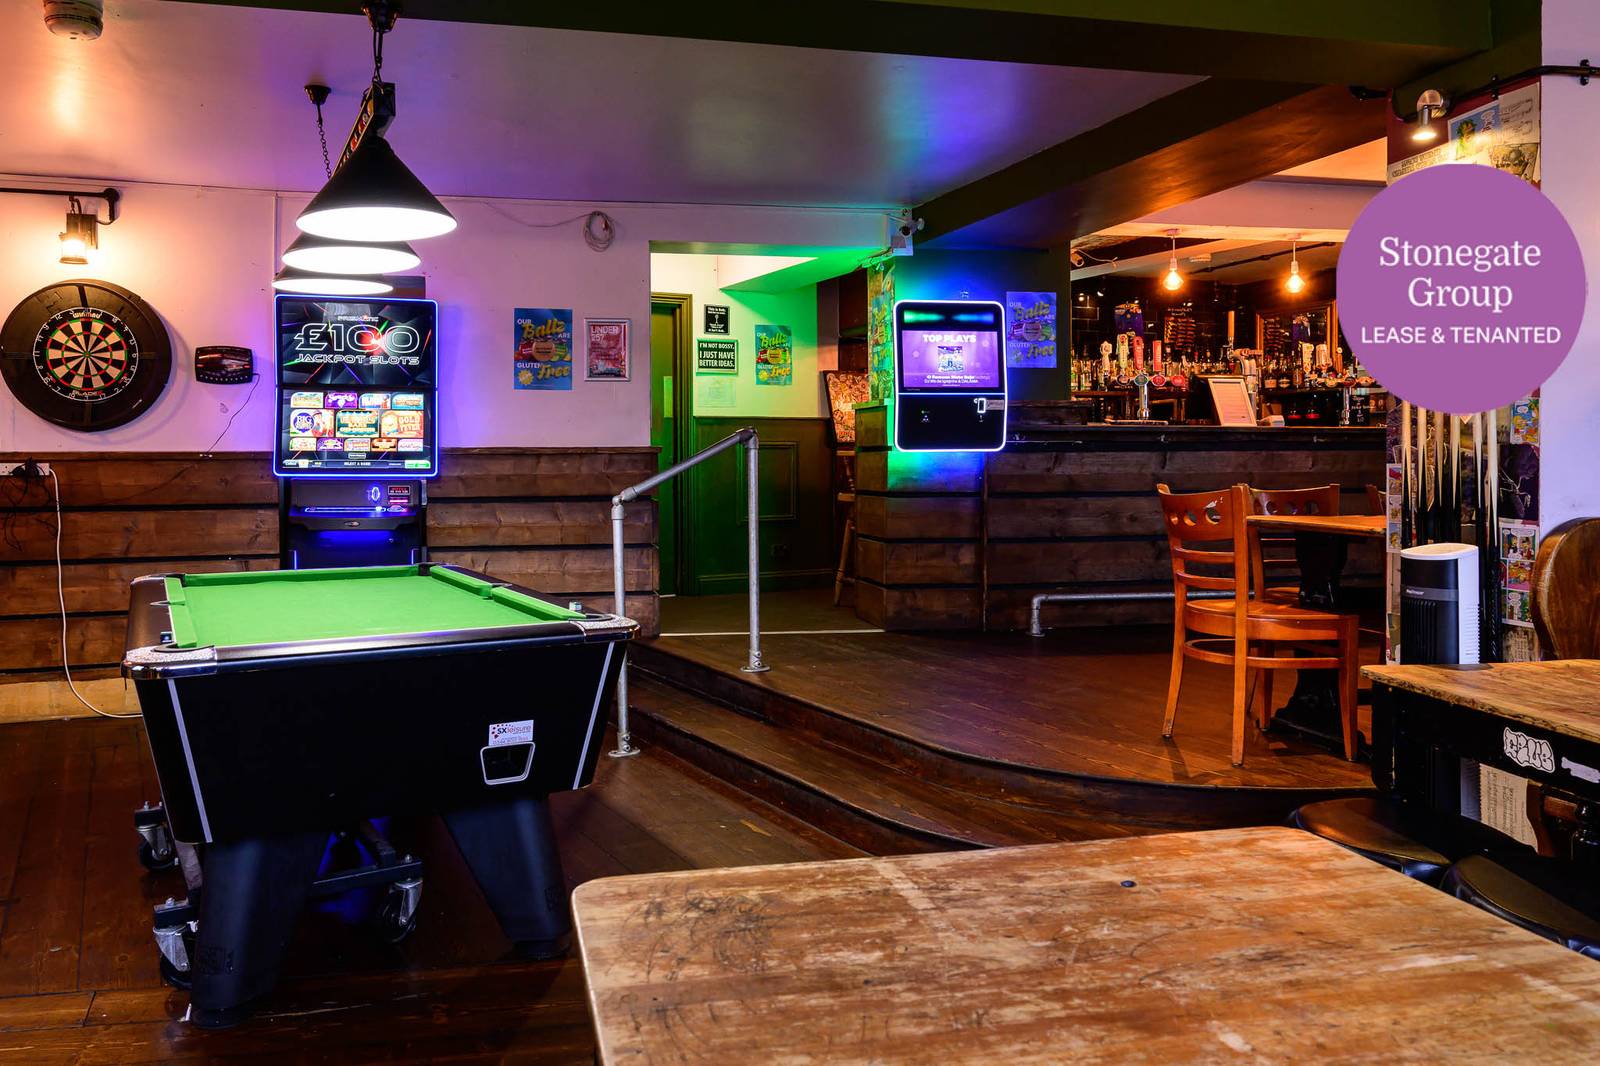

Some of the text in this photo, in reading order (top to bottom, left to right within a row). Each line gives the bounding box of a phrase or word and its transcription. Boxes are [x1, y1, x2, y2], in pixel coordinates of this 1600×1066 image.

[592, 326, 619, 335] UNDER
[294, 323, 420, 354] £100
[923, 334, 976, 343] TOP PLAYS
[296, 353, 420, 365] JACKPOT SLOTS
[702, 351, 718, 359] JUST
[718, 351, 735, 359] HAVE
[537, 364, 570, 379] Free
